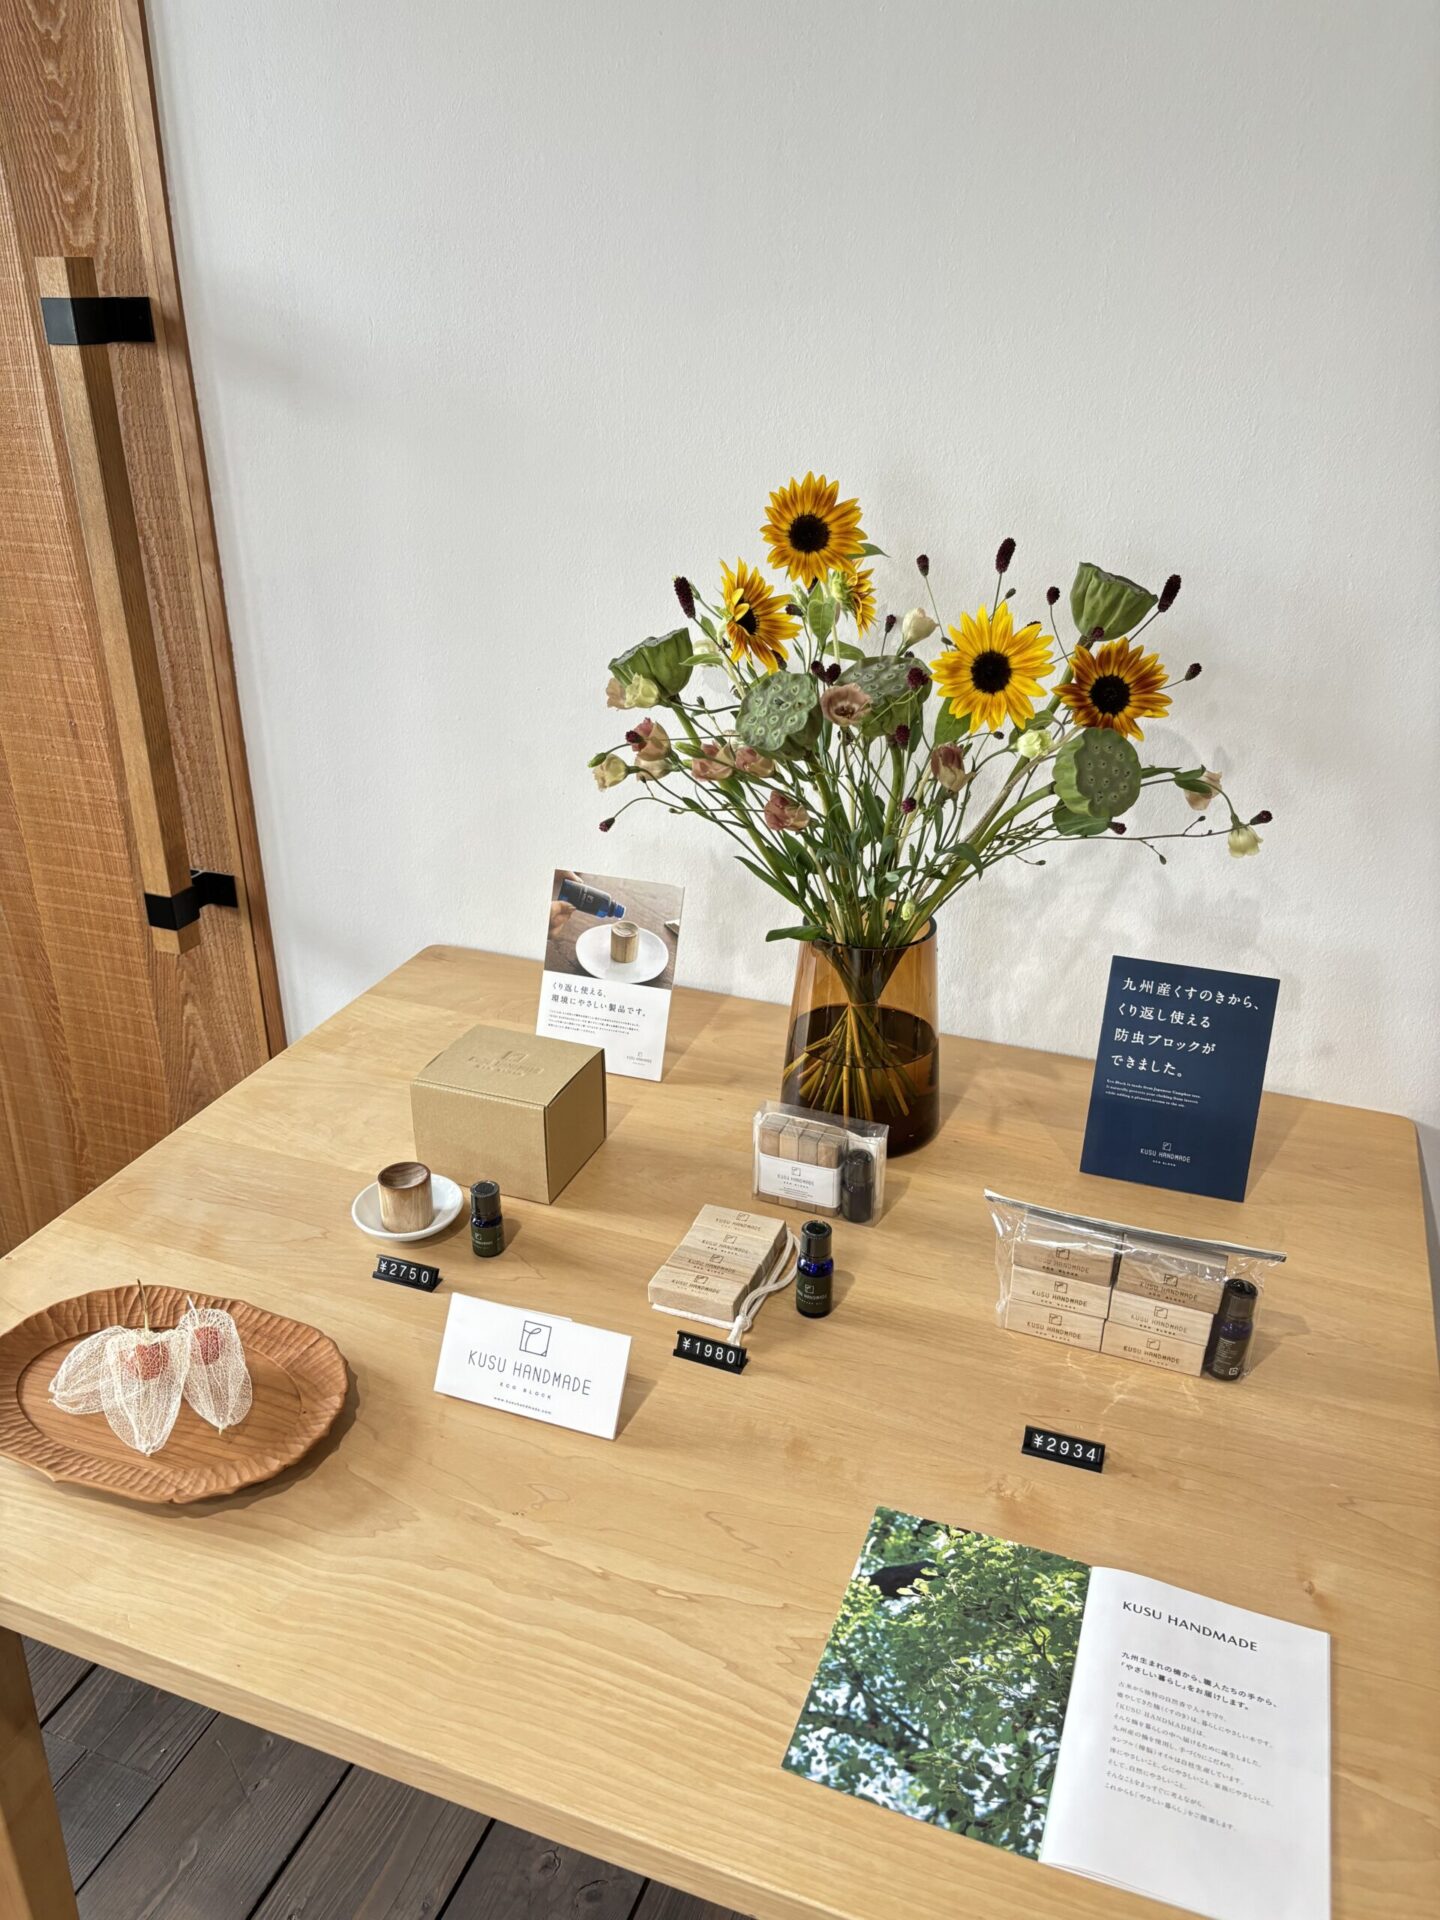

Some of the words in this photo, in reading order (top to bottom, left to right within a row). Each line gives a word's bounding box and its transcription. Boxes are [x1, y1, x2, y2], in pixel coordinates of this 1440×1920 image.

[552, 982, 606, 998] くり返し使える、
[1122, 977, 1259, 1010] 九州産くすのきから、
[551, 994, 646, 1016] 環境にやさしい製品です。
[1118, 1003, 1211, 1028] くり返し使える
[1114, 1028, 1216, 1055] 防虫ブロックが
[1111, 1054, 1182, 1078] できました。
[1140, 1148, 1156, 1156] KUSU
[1159, 1151, 1190, 1163] HANDMADE
[380, 1260, 429, 1284] ¥2750
[1052, 1260, 1090, 1274] HANDMADE
[1032, 1290, 1050, 1298] KUSU
[1052, 1294, 1088, 1307] HANDMADE
[1161, 1287, 1198, 1301] HANDMADE
[1026, 1321, 1044, 1330] KUSU
[1046, 1326, 1082, 1340] HANDMADE
[682, 1337, 736, 1364] ¥1980
[1124, 1345, 1142, 1354] KUSU
[1144, 1350, 1180, 1364] HANDMADE
[468, 1350, 507, 1373] KUSU
[513, 1361, 592, 1396] HANDMADE
[1034, 1434, 1096, 1462] ¥2934
[1122, 1600, 1162, 1620] KUSU
[1167, 1614, 1258, 1652] HANDMADE
